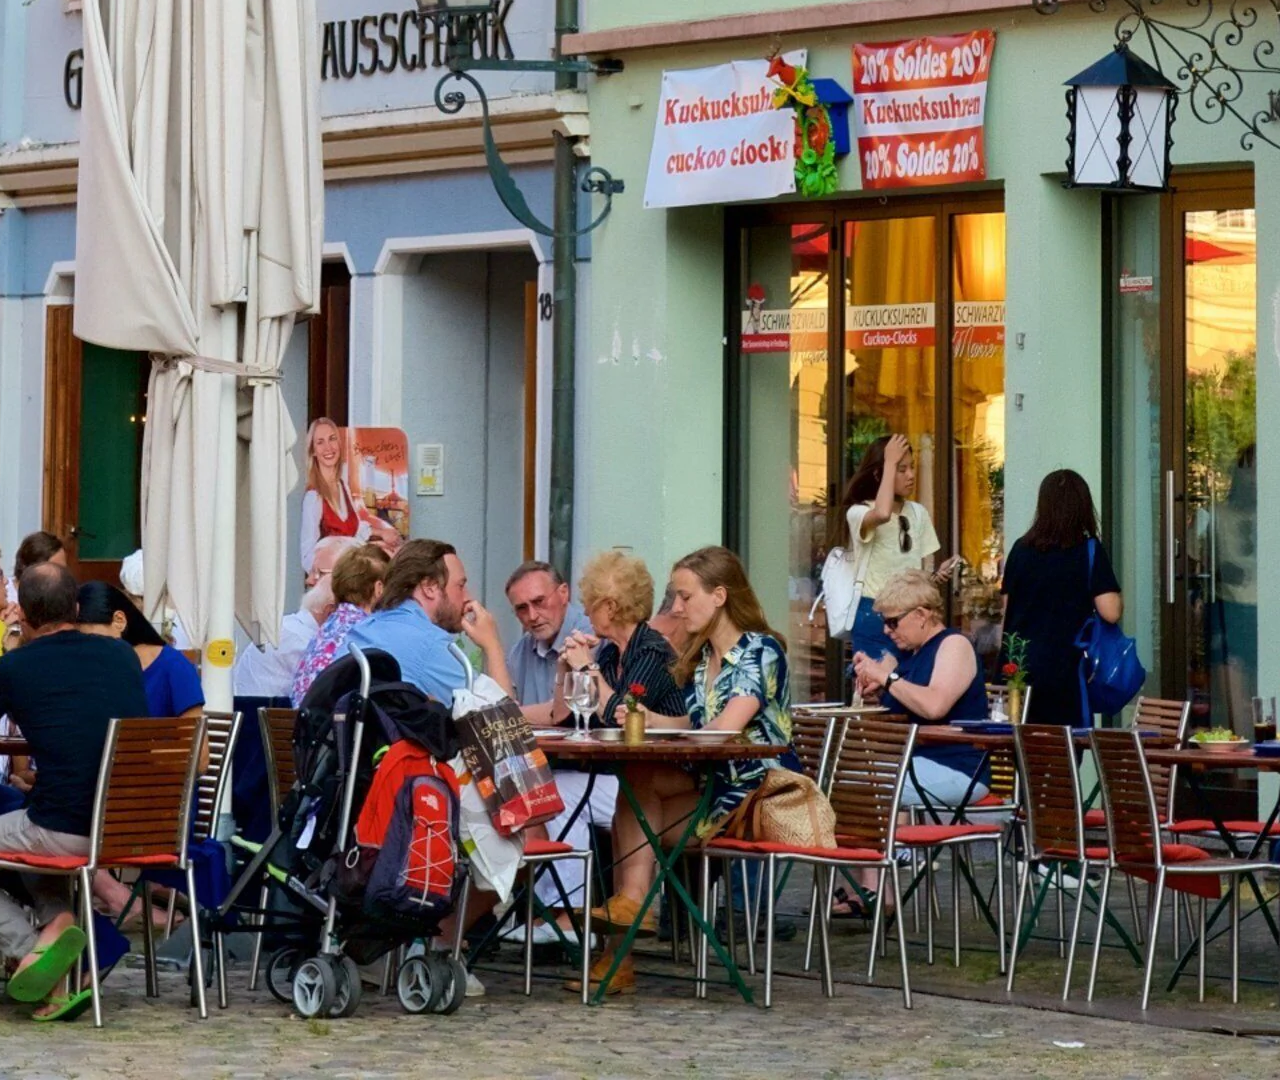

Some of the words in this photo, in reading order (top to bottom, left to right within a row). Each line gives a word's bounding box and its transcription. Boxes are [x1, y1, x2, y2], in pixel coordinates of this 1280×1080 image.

[892, 44, 948, 82] Soldes
[950, 38, 988, 78] 20%
[863, 92, 981, 125] Kuckucksuhren
[666, 145, 726, 174] cuckoo
[895, 140, 950, 178] Soldes
[951, 135, 979, 174] 20%
[539, 292, 553, 321] 18
[853, 306, 929, 328] KUCKUCKSUHREN
